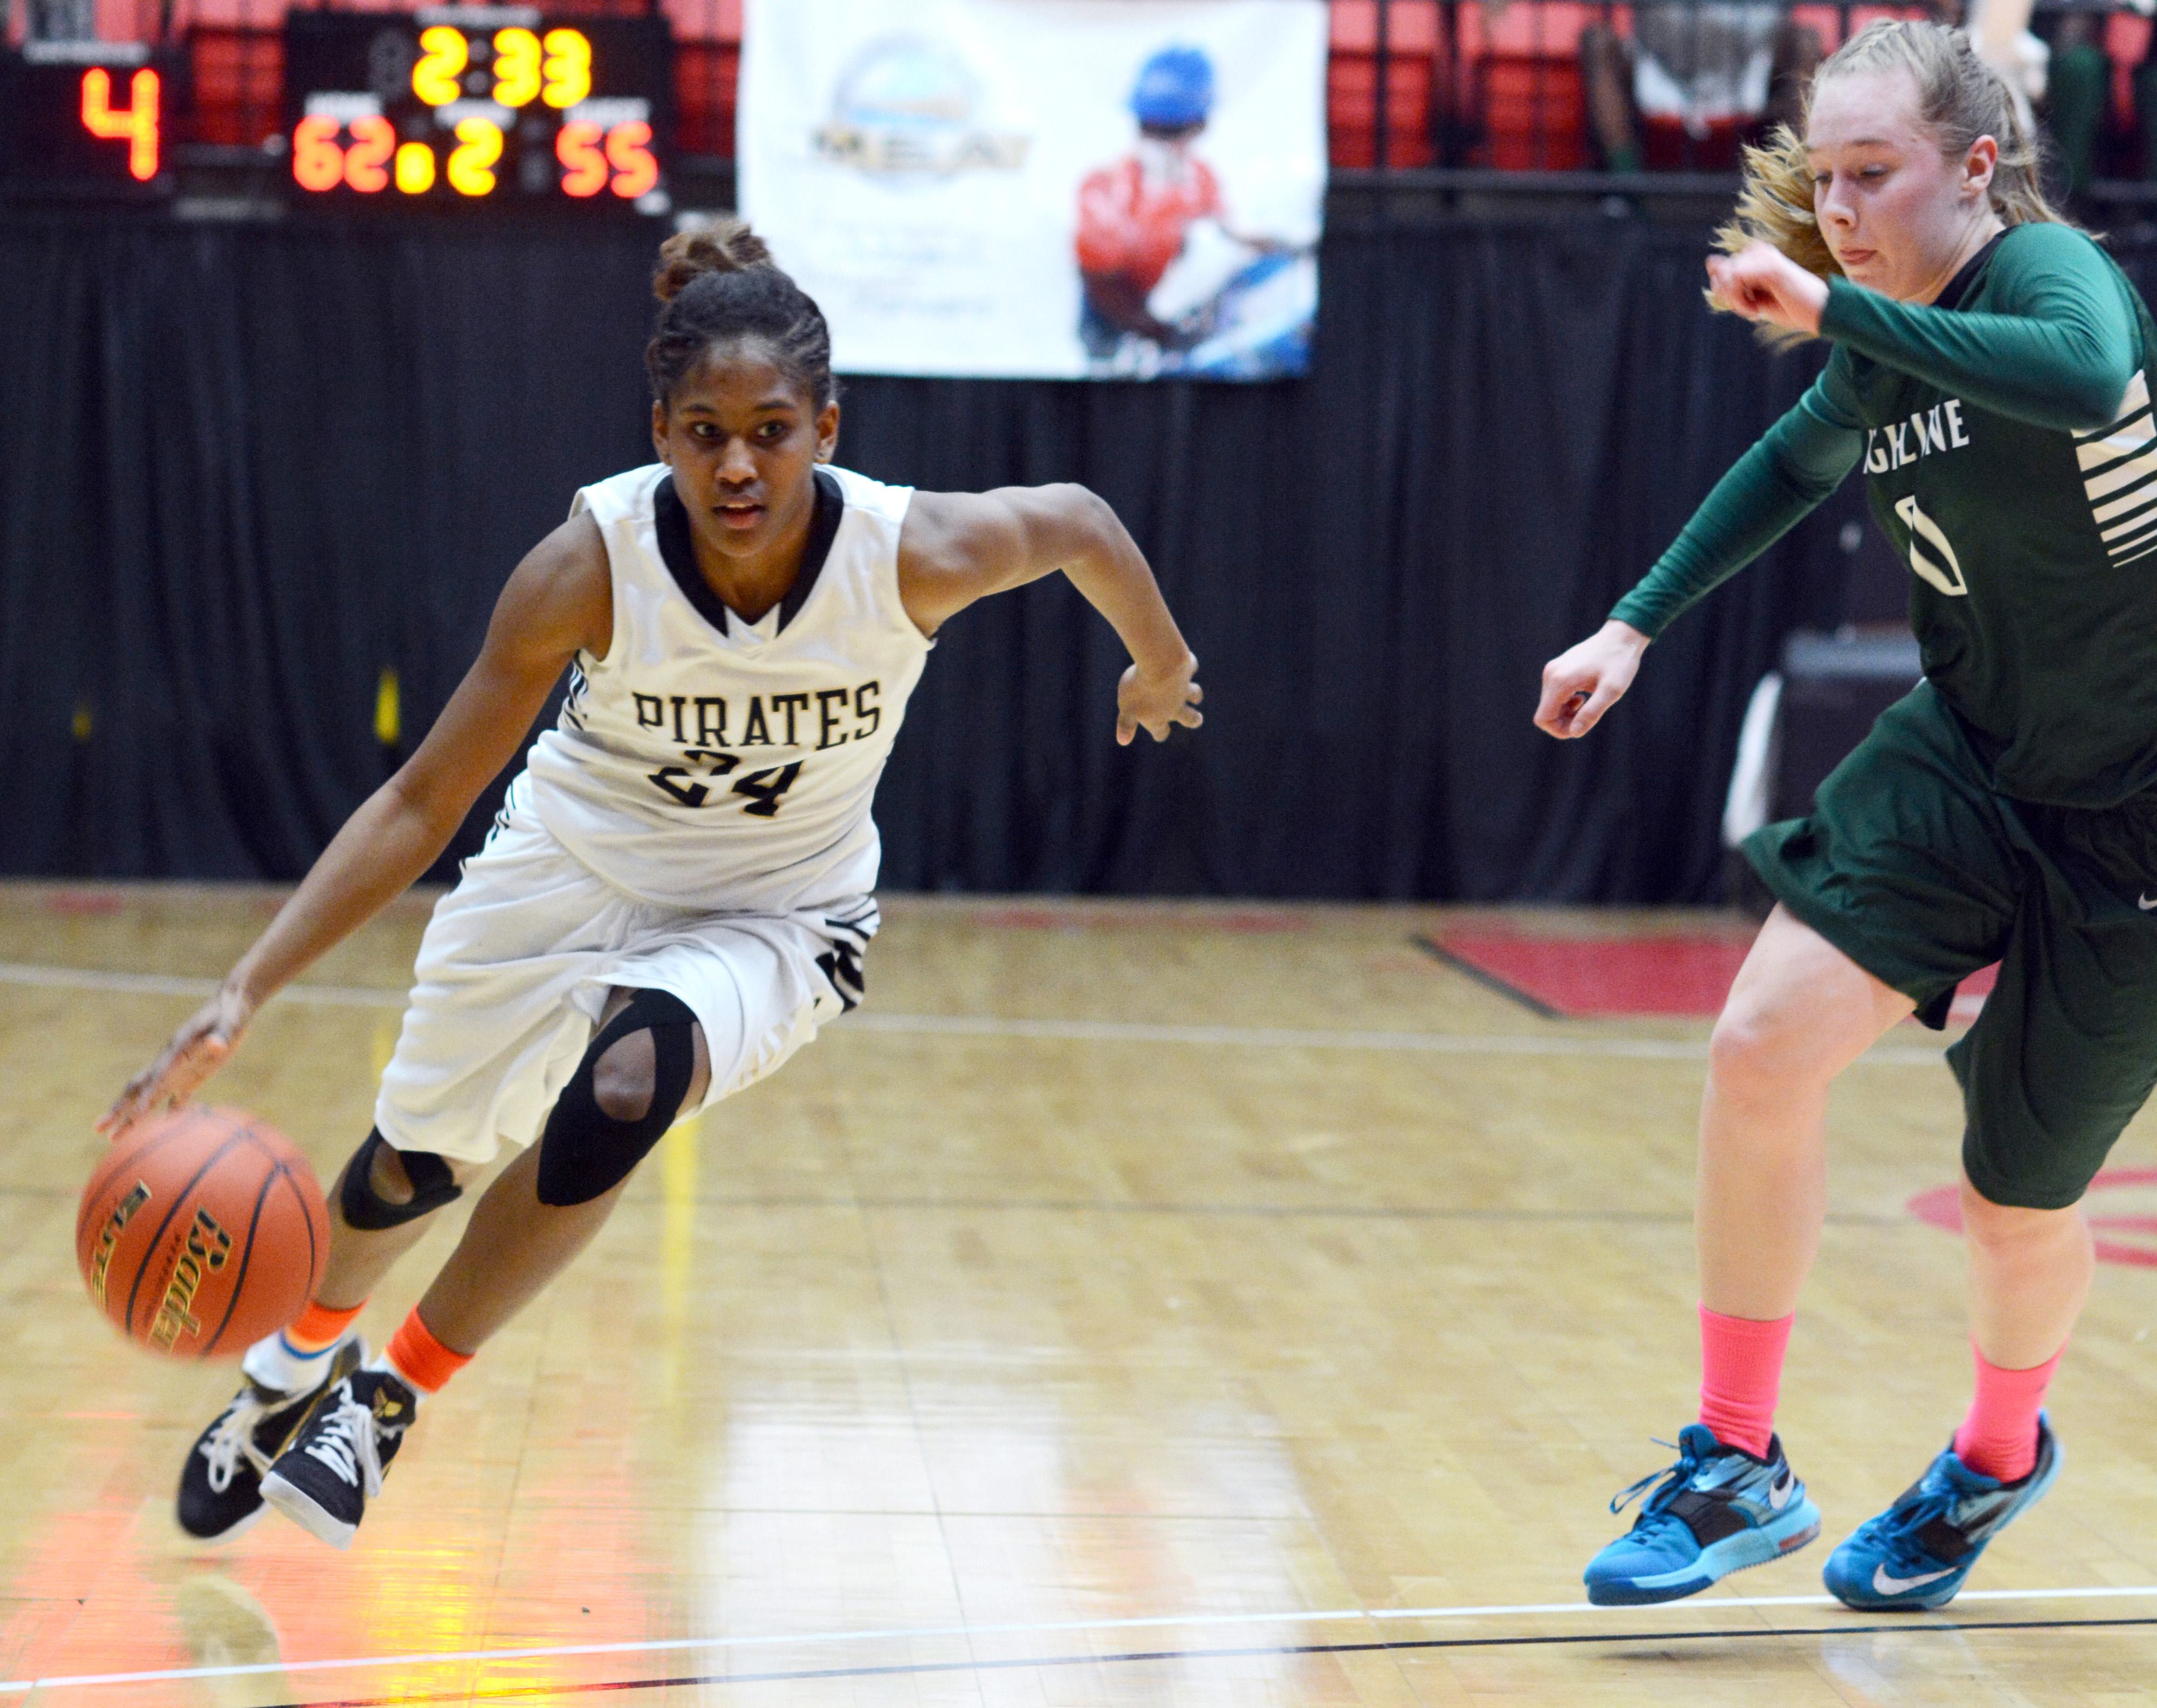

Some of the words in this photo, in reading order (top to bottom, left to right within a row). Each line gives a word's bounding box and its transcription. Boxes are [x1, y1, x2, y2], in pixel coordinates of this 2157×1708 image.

[83, 66, 160, 181] 4
[557, 120, 656, 197] 55
[632, 680, 882, 750] PIRATES
[647, 749, 805, 817] 24
